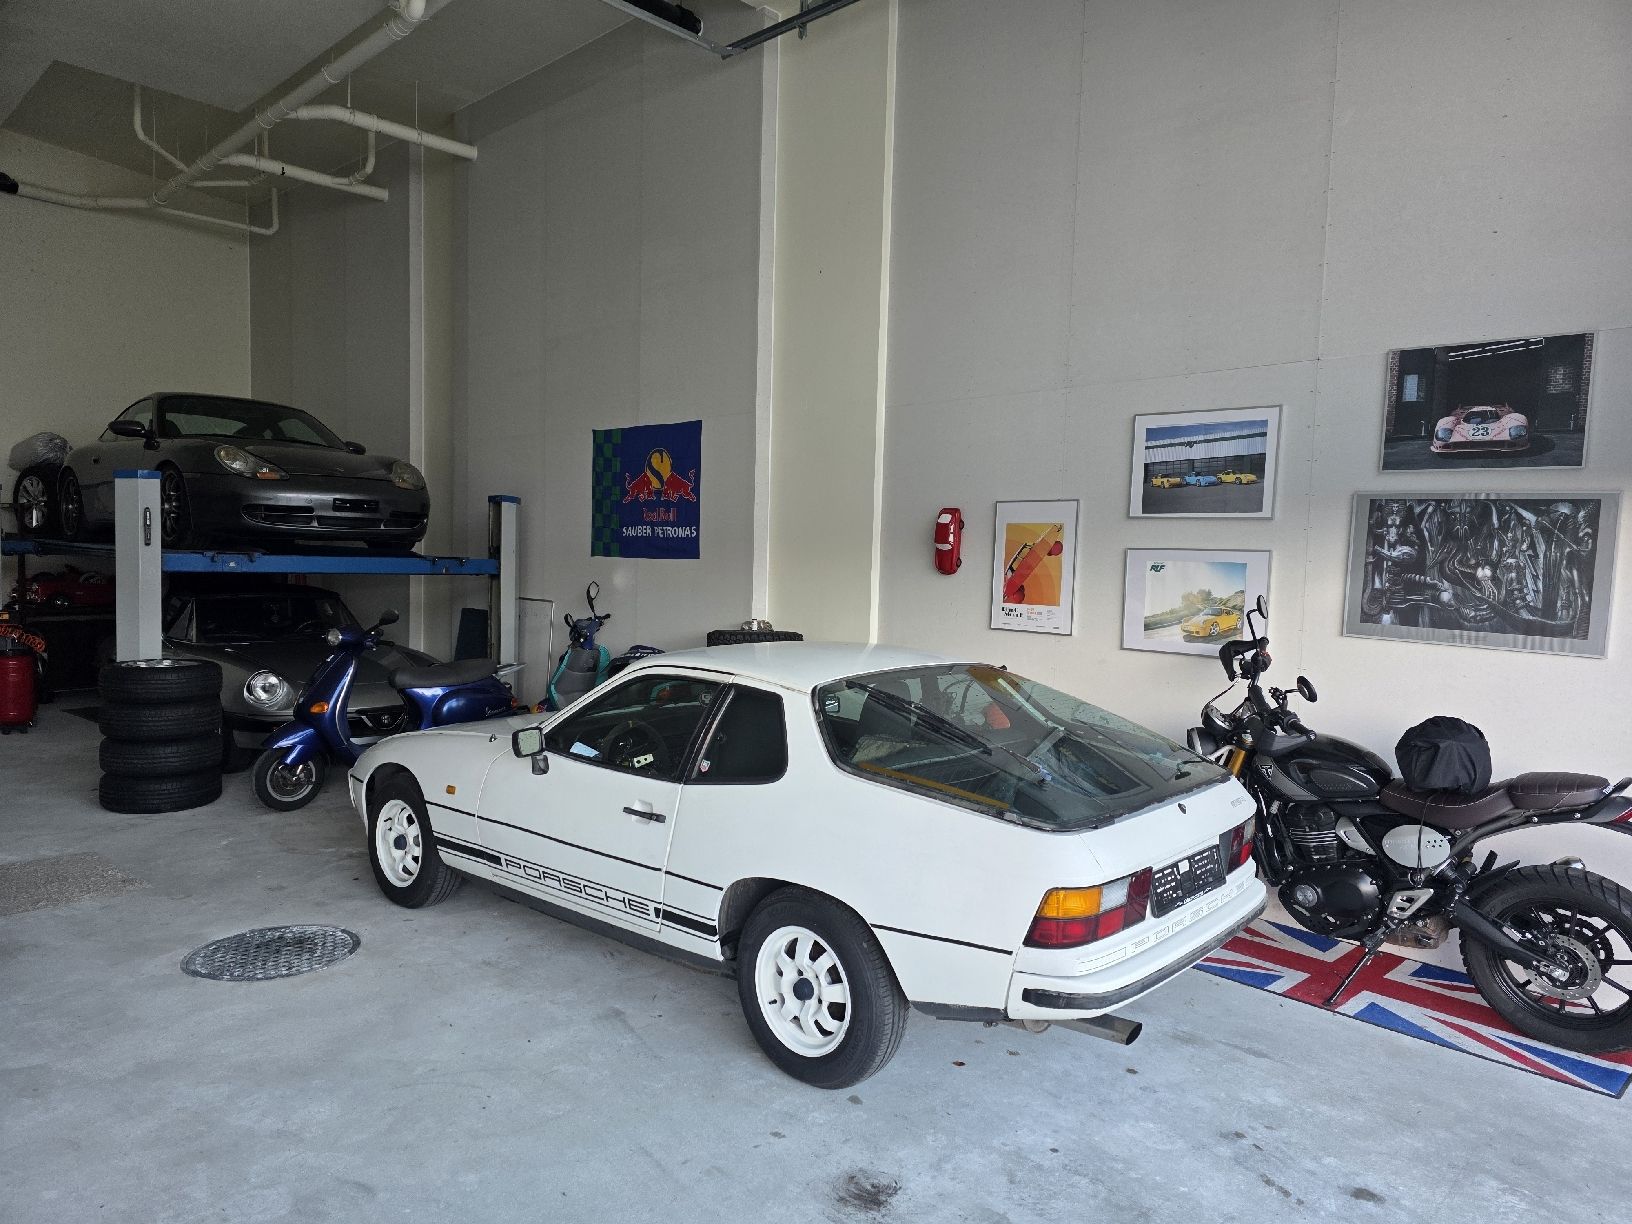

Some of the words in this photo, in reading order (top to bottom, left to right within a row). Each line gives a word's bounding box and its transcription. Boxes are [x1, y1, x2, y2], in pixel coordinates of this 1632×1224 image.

[1472, 426, 1489, 436] 23
[622, 525, 652, 536] SAUBER
[655, 526, 696, 537] PETRONAS
[504, 857, 651, 917] PORSCHE
